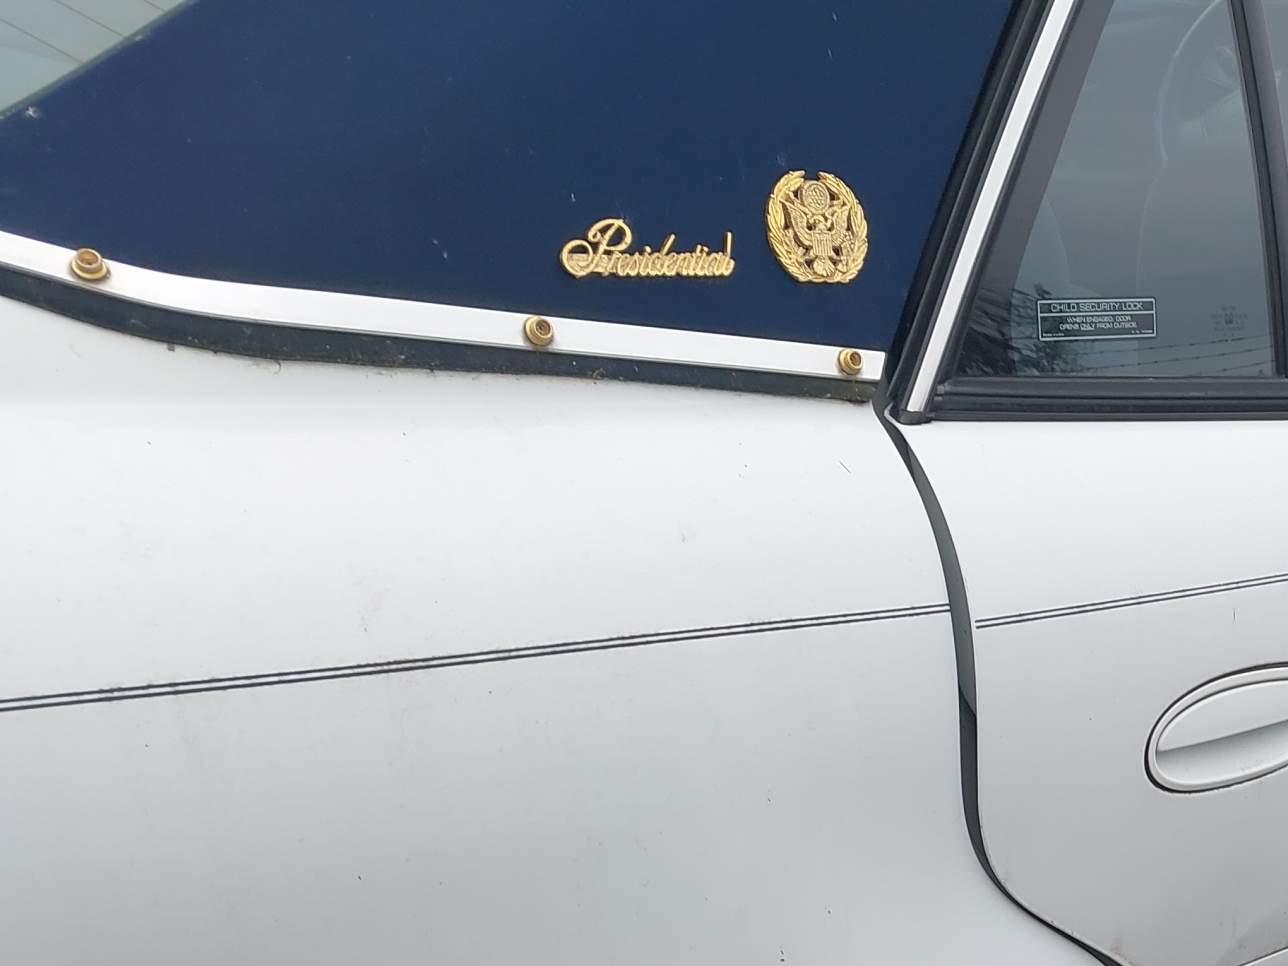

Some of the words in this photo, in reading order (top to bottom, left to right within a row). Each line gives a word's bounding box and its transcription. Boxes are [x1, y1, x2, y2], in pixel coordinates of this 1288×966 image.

[561, 218, 735, 278] Presidential
[1050, 302, 1077, 312] CHILD
[1079, 302, 1120, 312] SECURITY
[1122, 301, 1144, 311] LOCK
